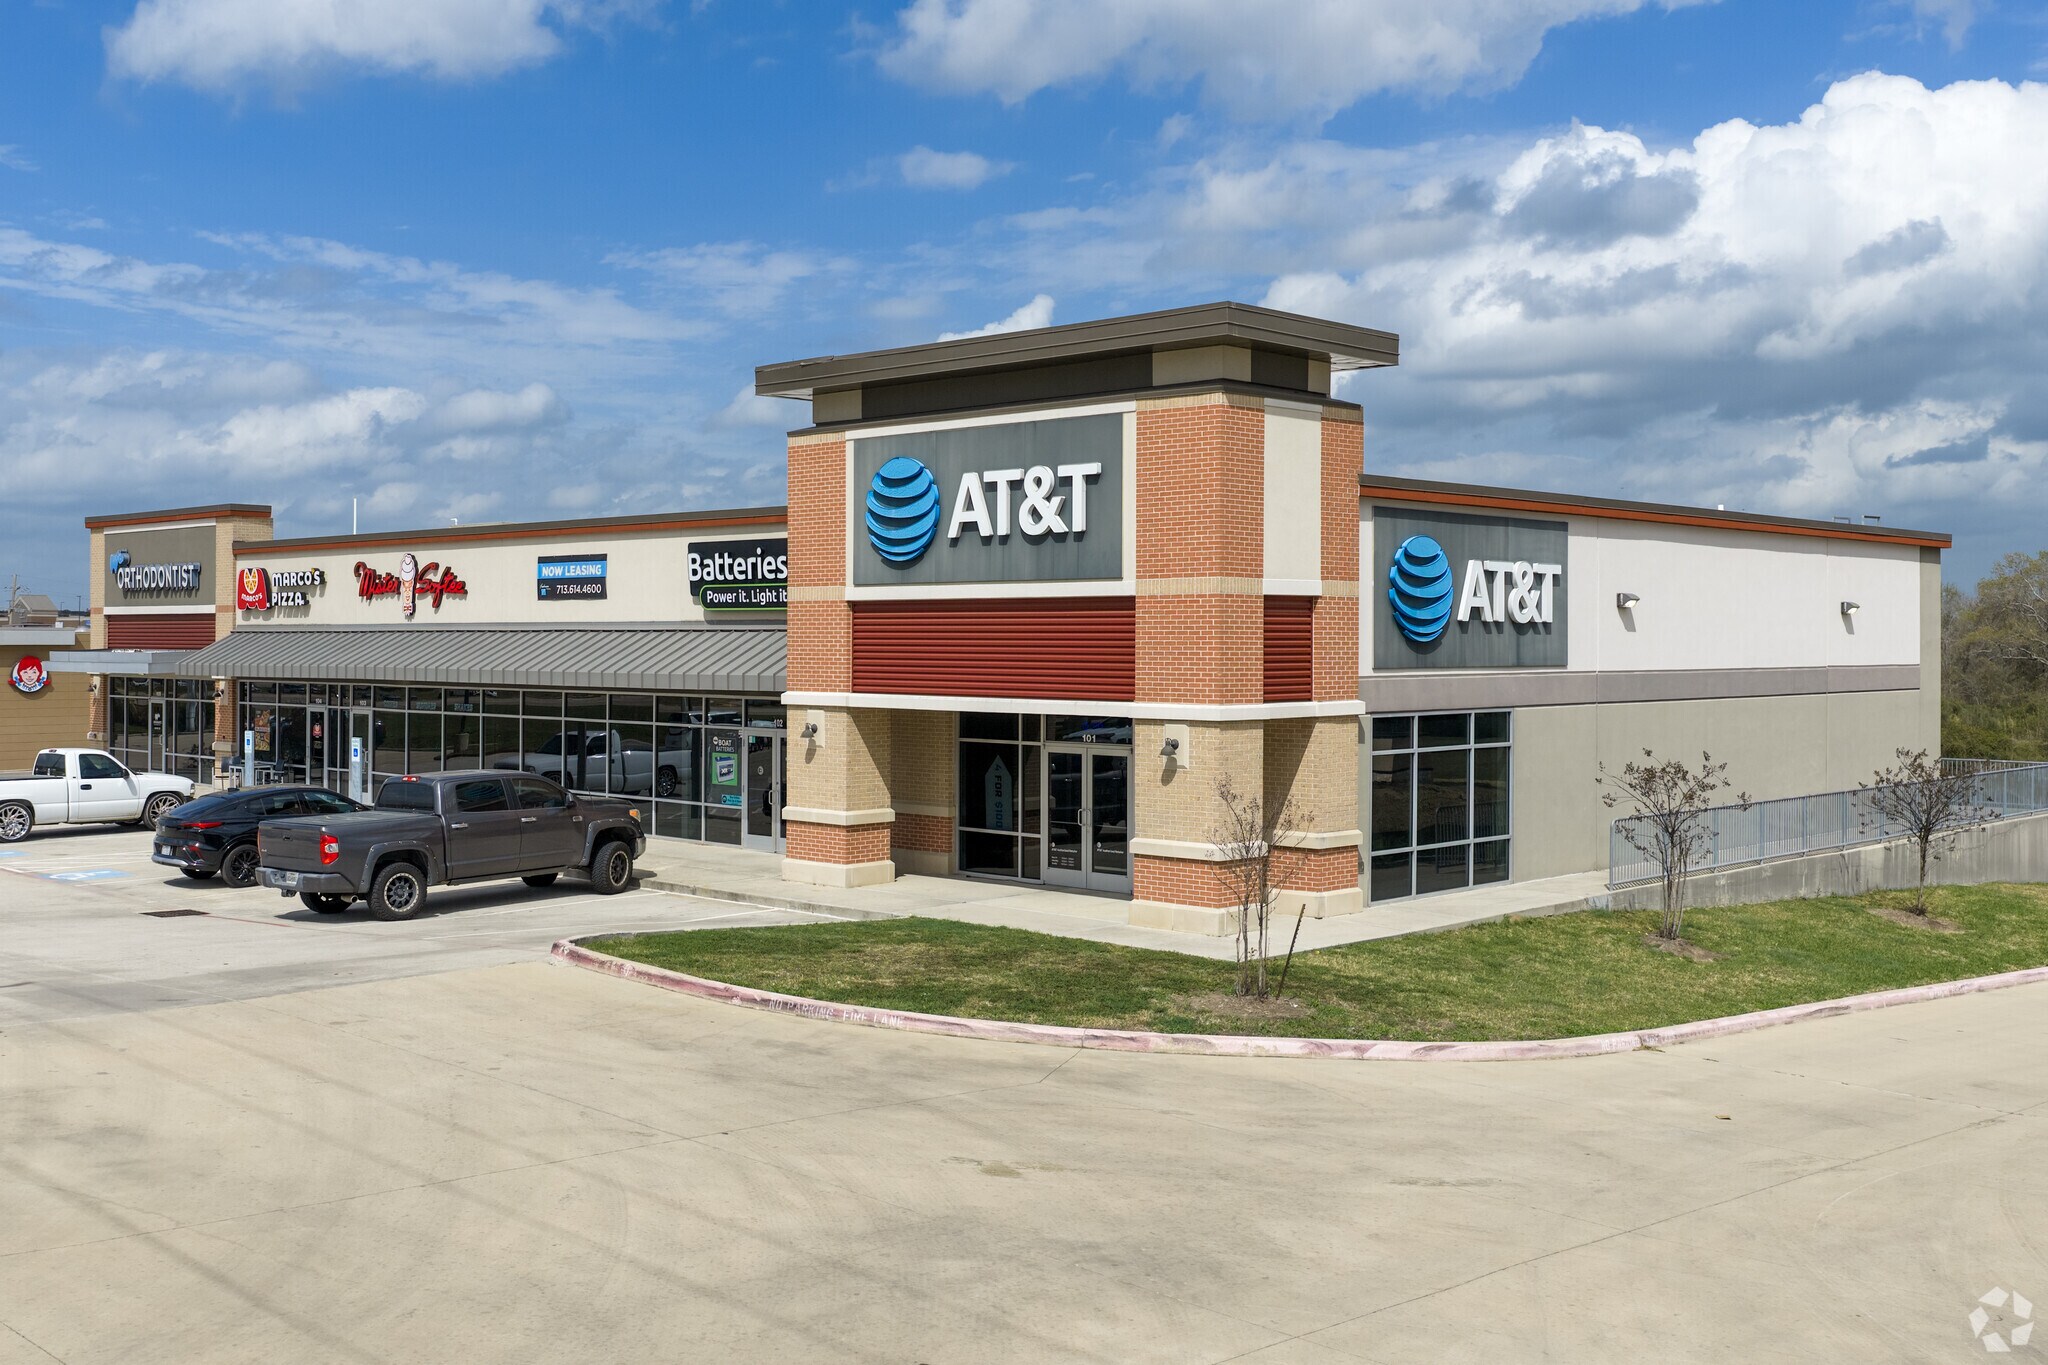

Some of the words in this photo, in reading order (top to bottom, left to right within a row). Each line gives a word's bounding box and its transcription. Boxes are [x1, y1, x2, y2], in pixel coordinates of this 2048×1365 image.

[947, 462, 1102, 539] AT&T
[542, 566, 563, 577] NOW
[565, 564, 602, 576] LEASING
[687, 546, 788, 582] Batteries
[117, 563, 199, 589] ORTHODONTIST
[272, 569, 321, 587] MARCO'S
[354, 561, 401, 600] Mister
[415, 562, 468, 608] Softee
[272, 591, 303, 607] PIZZA
[556, 584, 602, 595] 713.614.4600
[706, 590, 737, 603] Power
[738, 589, 749, 603] it.
[751, 588, 777, 605] Light
[779, 588, 788, 602] it
[1457, 559, 1562, 624] AT&T
[1082, 734, 1096, 743] 101
[994, 775, 1003, 798] FOR
[768, 999, 783, 1010] NO
[787, 1001, 834, 1018] PARKING
